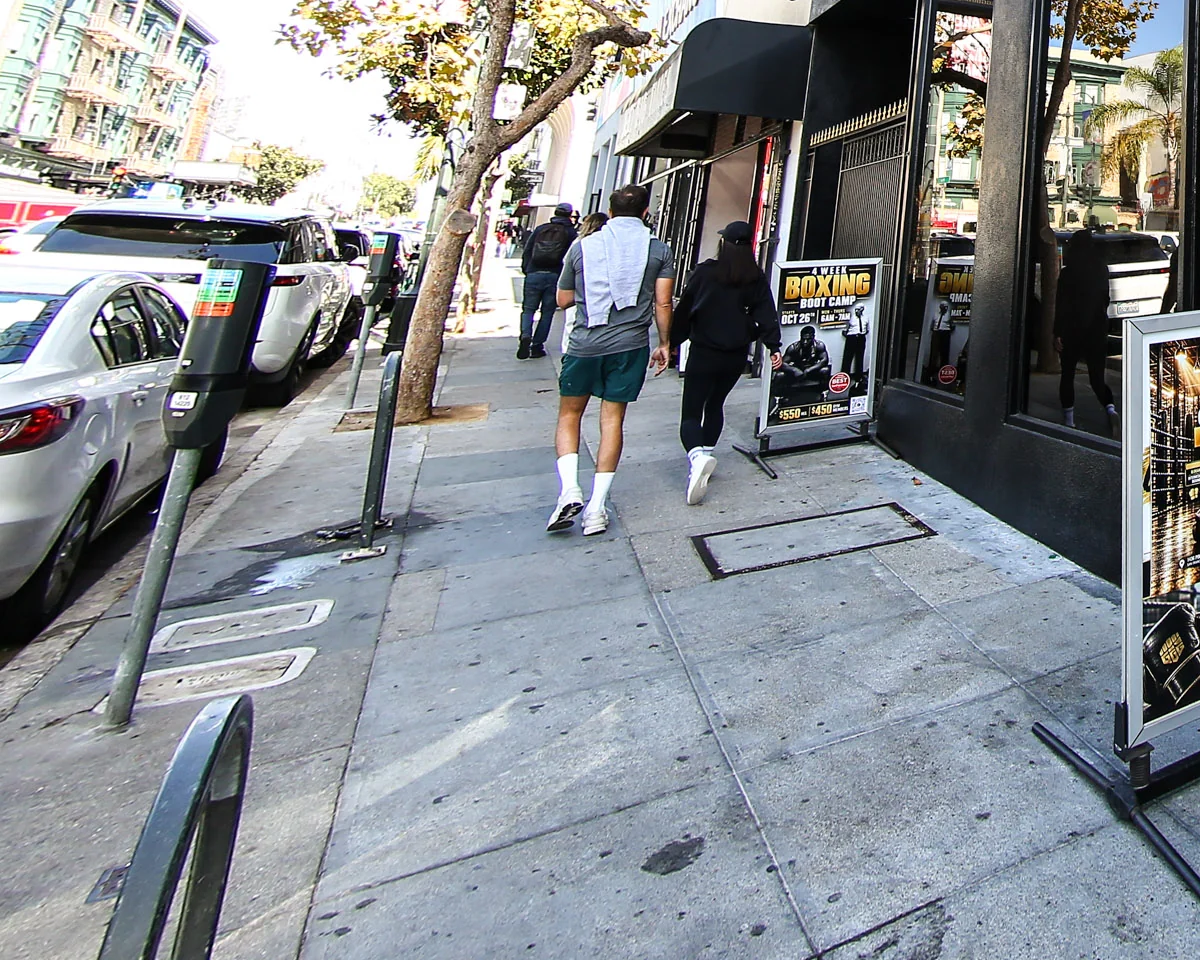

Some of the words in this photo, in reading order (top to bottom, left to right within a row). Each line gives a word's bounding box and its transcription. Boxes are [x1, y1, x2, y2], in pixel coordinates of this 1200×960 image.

[811, 266, 818, 275] 4
[820, 266, 848, 275] WEEK
[784, 272, 871, 300] BOXING
[800, 297, 826, 309] BOOT
[828, 295, 857, 307] CAMP
[781, 314, 798, 325] OCT
[779, 408, 801, 420] $550
[811, 403, 832, 415] $450
